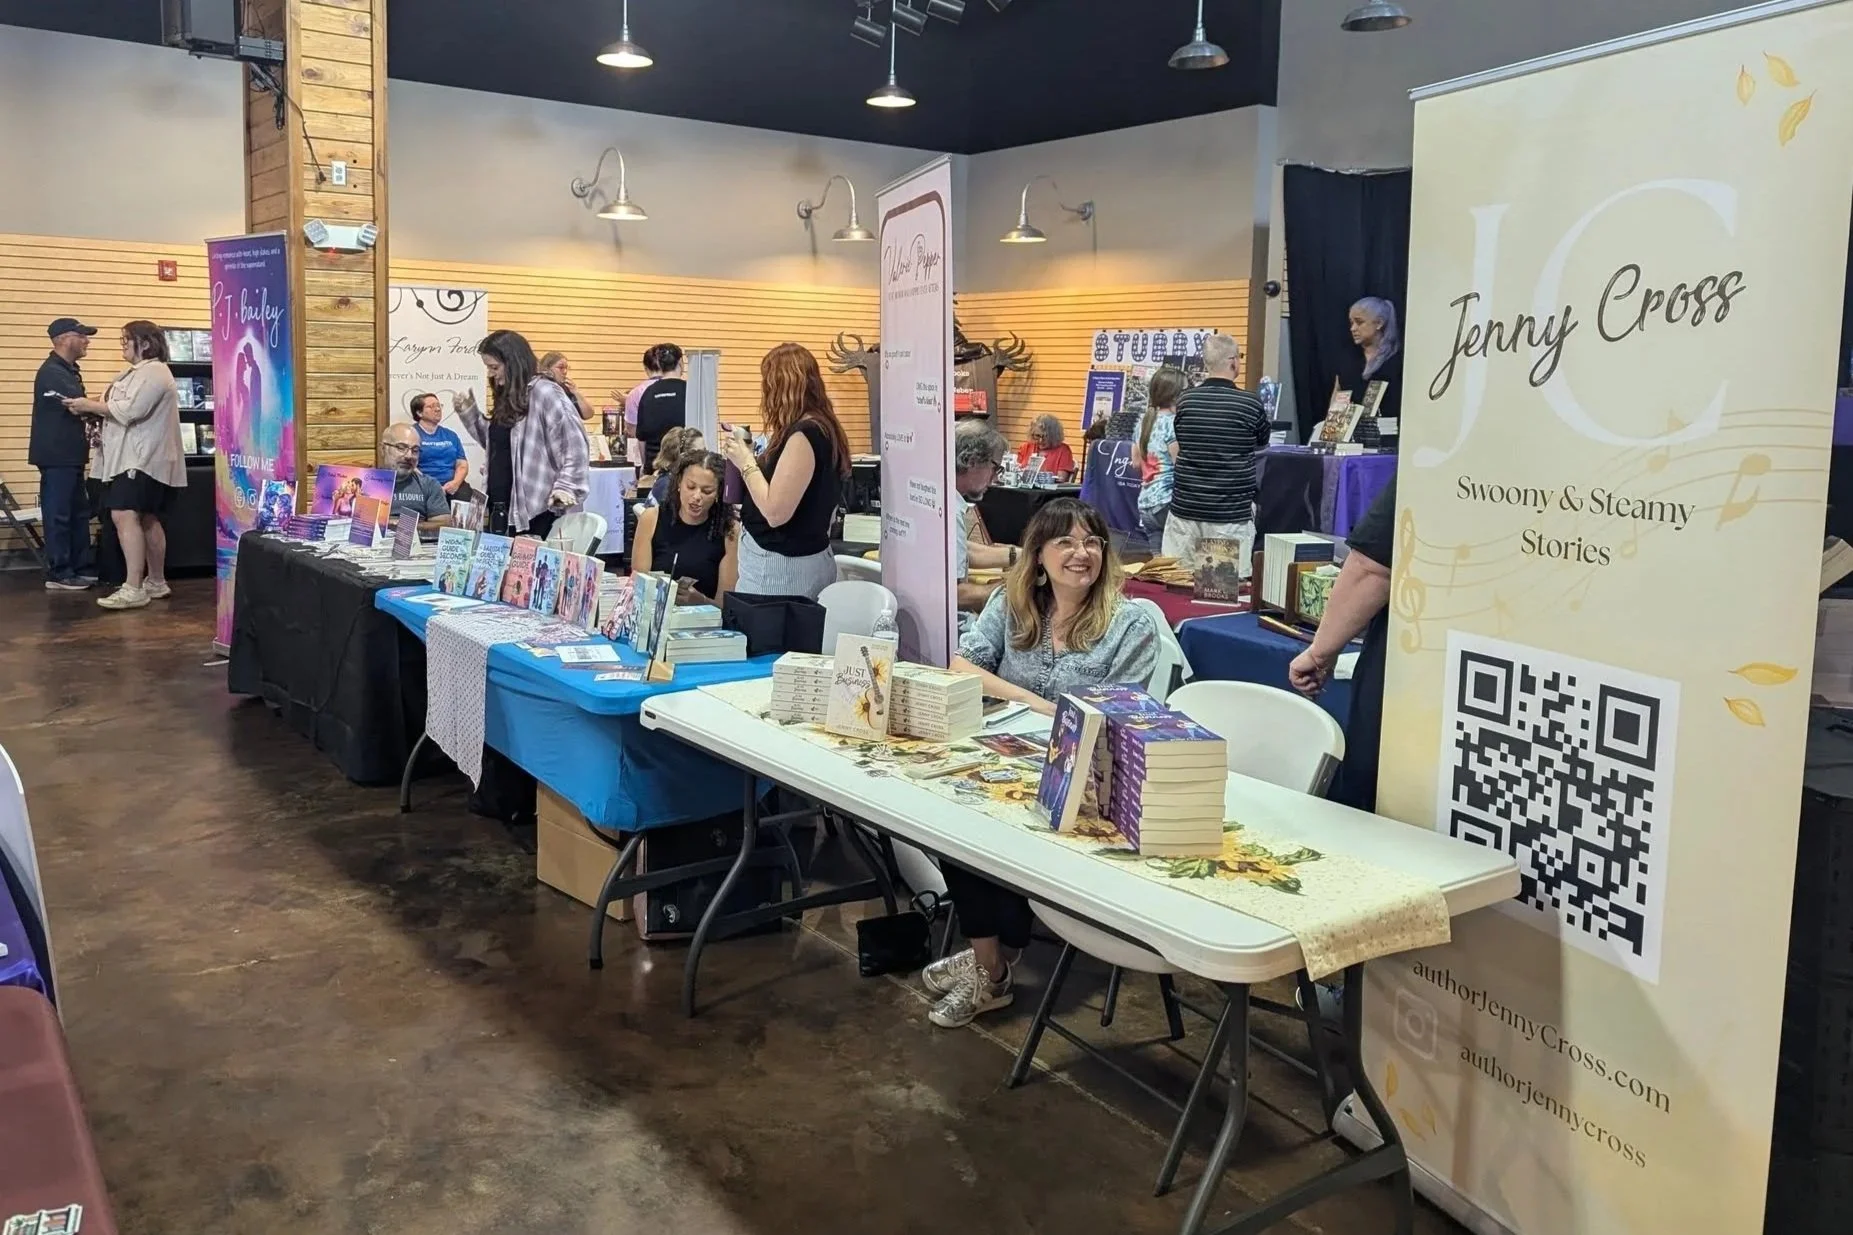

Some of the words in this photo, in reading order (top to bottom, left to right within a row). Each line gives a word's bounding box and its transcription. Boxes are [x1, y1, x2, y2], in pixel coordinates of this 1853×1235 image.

[1429, 291, 1579, 401] Jenny
[1597, 263, 1746, 343] Cross
[415, 371, 429, 380] Not
[431, 372, 444, 381] Just
[446, 373, 453, 381] A
[454, 373, 479, 381] Dream
[230, 453, 259, 471] FOLLOW
[261, 456, 275, 472] ME
[398, 492, 425, 502] RESOURCE
[1456, 475, 1554, 514] Swoony
[1558, 485, 1584, 512] &
[1589, 487, 1696, 531] Steamy
[1520, 528, 1612, 567] Stories
[834, 672, 872, 690] Business
[843, 665, 866, 678] JUST
[1412, 960, 1671, 1114] authorJennyCross.com
[1459, 1044, 1647, 1169] authorjennycross
